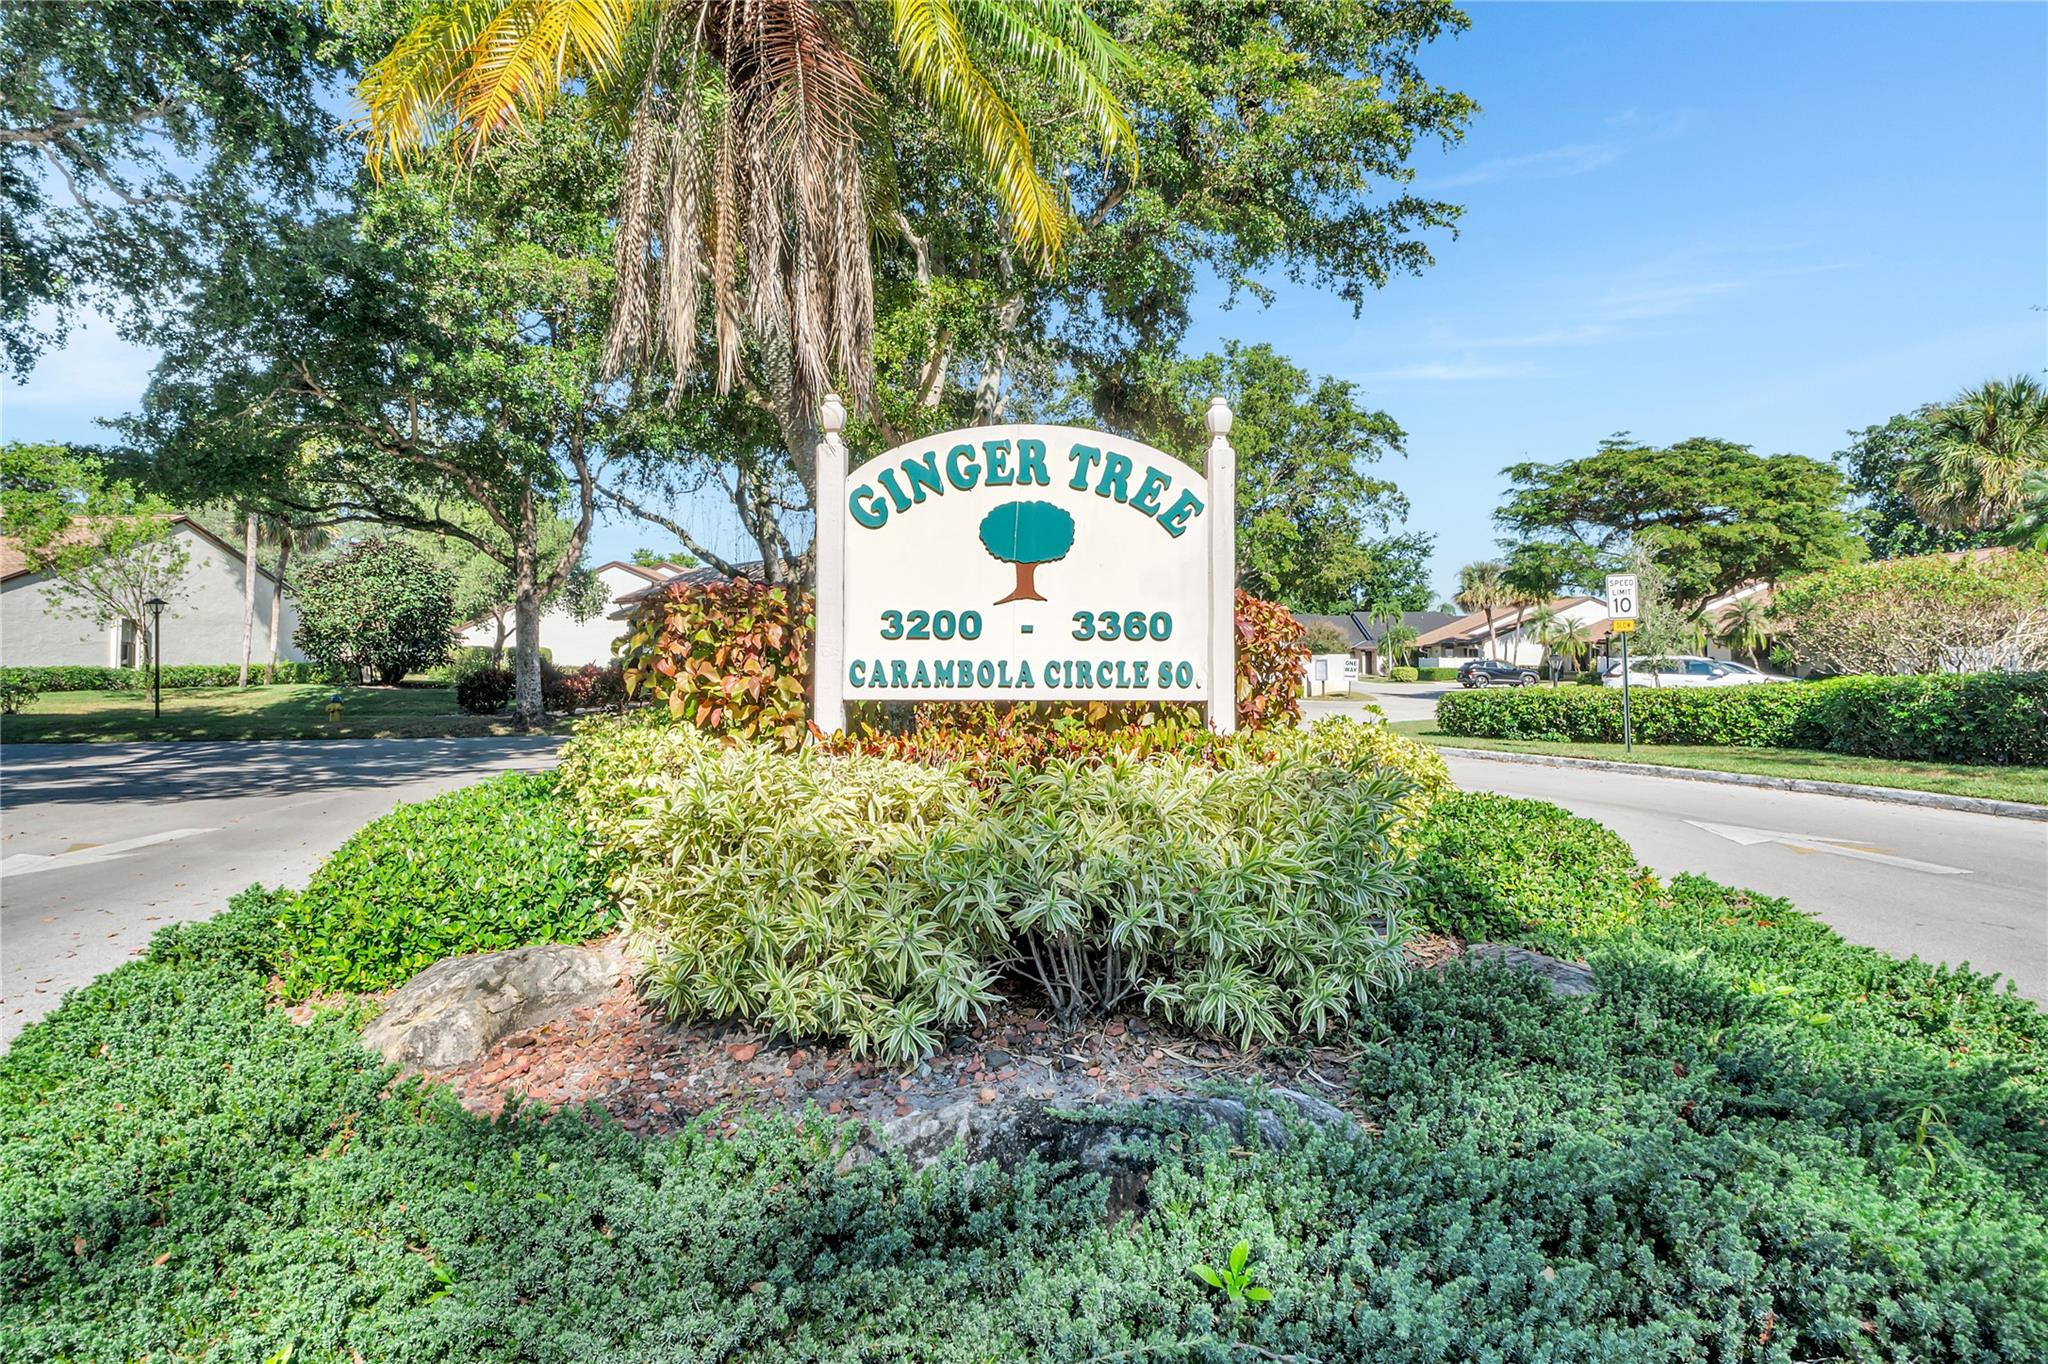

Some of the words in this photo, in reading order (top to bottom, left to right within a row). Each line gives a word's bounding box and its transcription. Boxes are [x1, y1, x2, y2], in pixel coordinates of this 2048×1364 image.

[848, 438, 1051, 529] GINGER
[1068, 443, 1205, 538] TREE
[1609, 579, 1634, 587] SPEED
[1612, 588, 1632, 596] LIMIT
[1613, 597, 1632, 613] 10
[880, 610, 982, 640] 3200
[1020, 624, 1034, 634] -
[1071, 611, 1173, 641] 3360
[848, 659, 1035, 688] CARAMBOLA
[1043, 660, 1149, 689] CIRCLE
